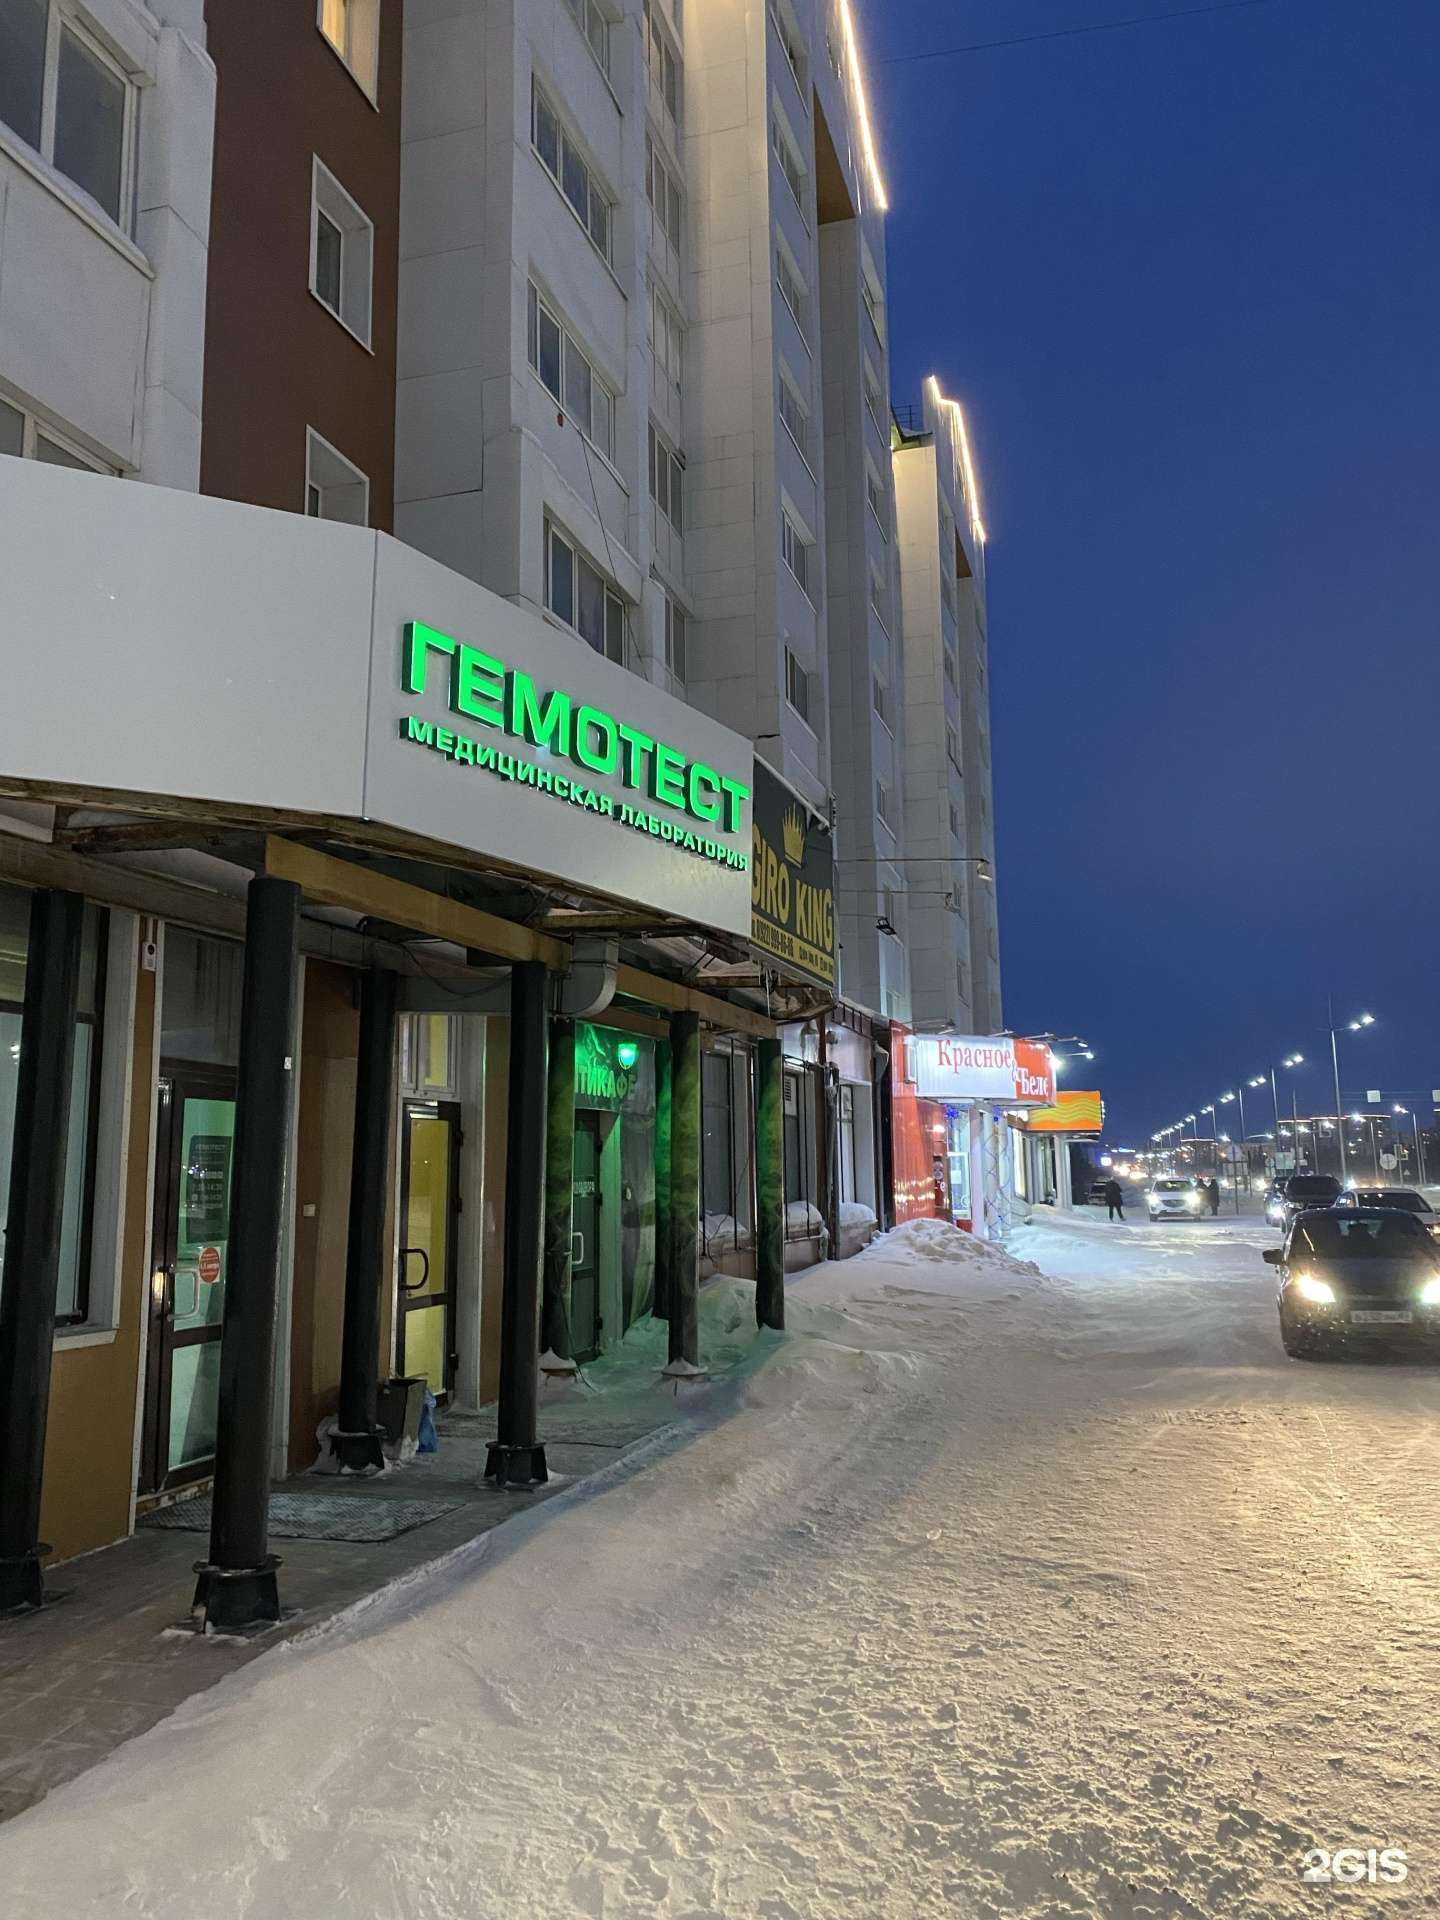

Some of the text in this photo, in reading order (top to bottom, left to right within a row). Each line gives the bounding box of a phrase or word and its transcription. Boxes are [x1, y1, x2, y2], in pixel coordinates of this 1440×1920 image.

[403, 715, 749, 871] МЕДИЦИНСКАЯ ЛАБОРАТОРИЯ
[407, 620, 751, 834] ГЕМОТЕСТ
[752, 823, 834, 953] GIRO KING
[936, 1039, 1011, 1074] Красное
